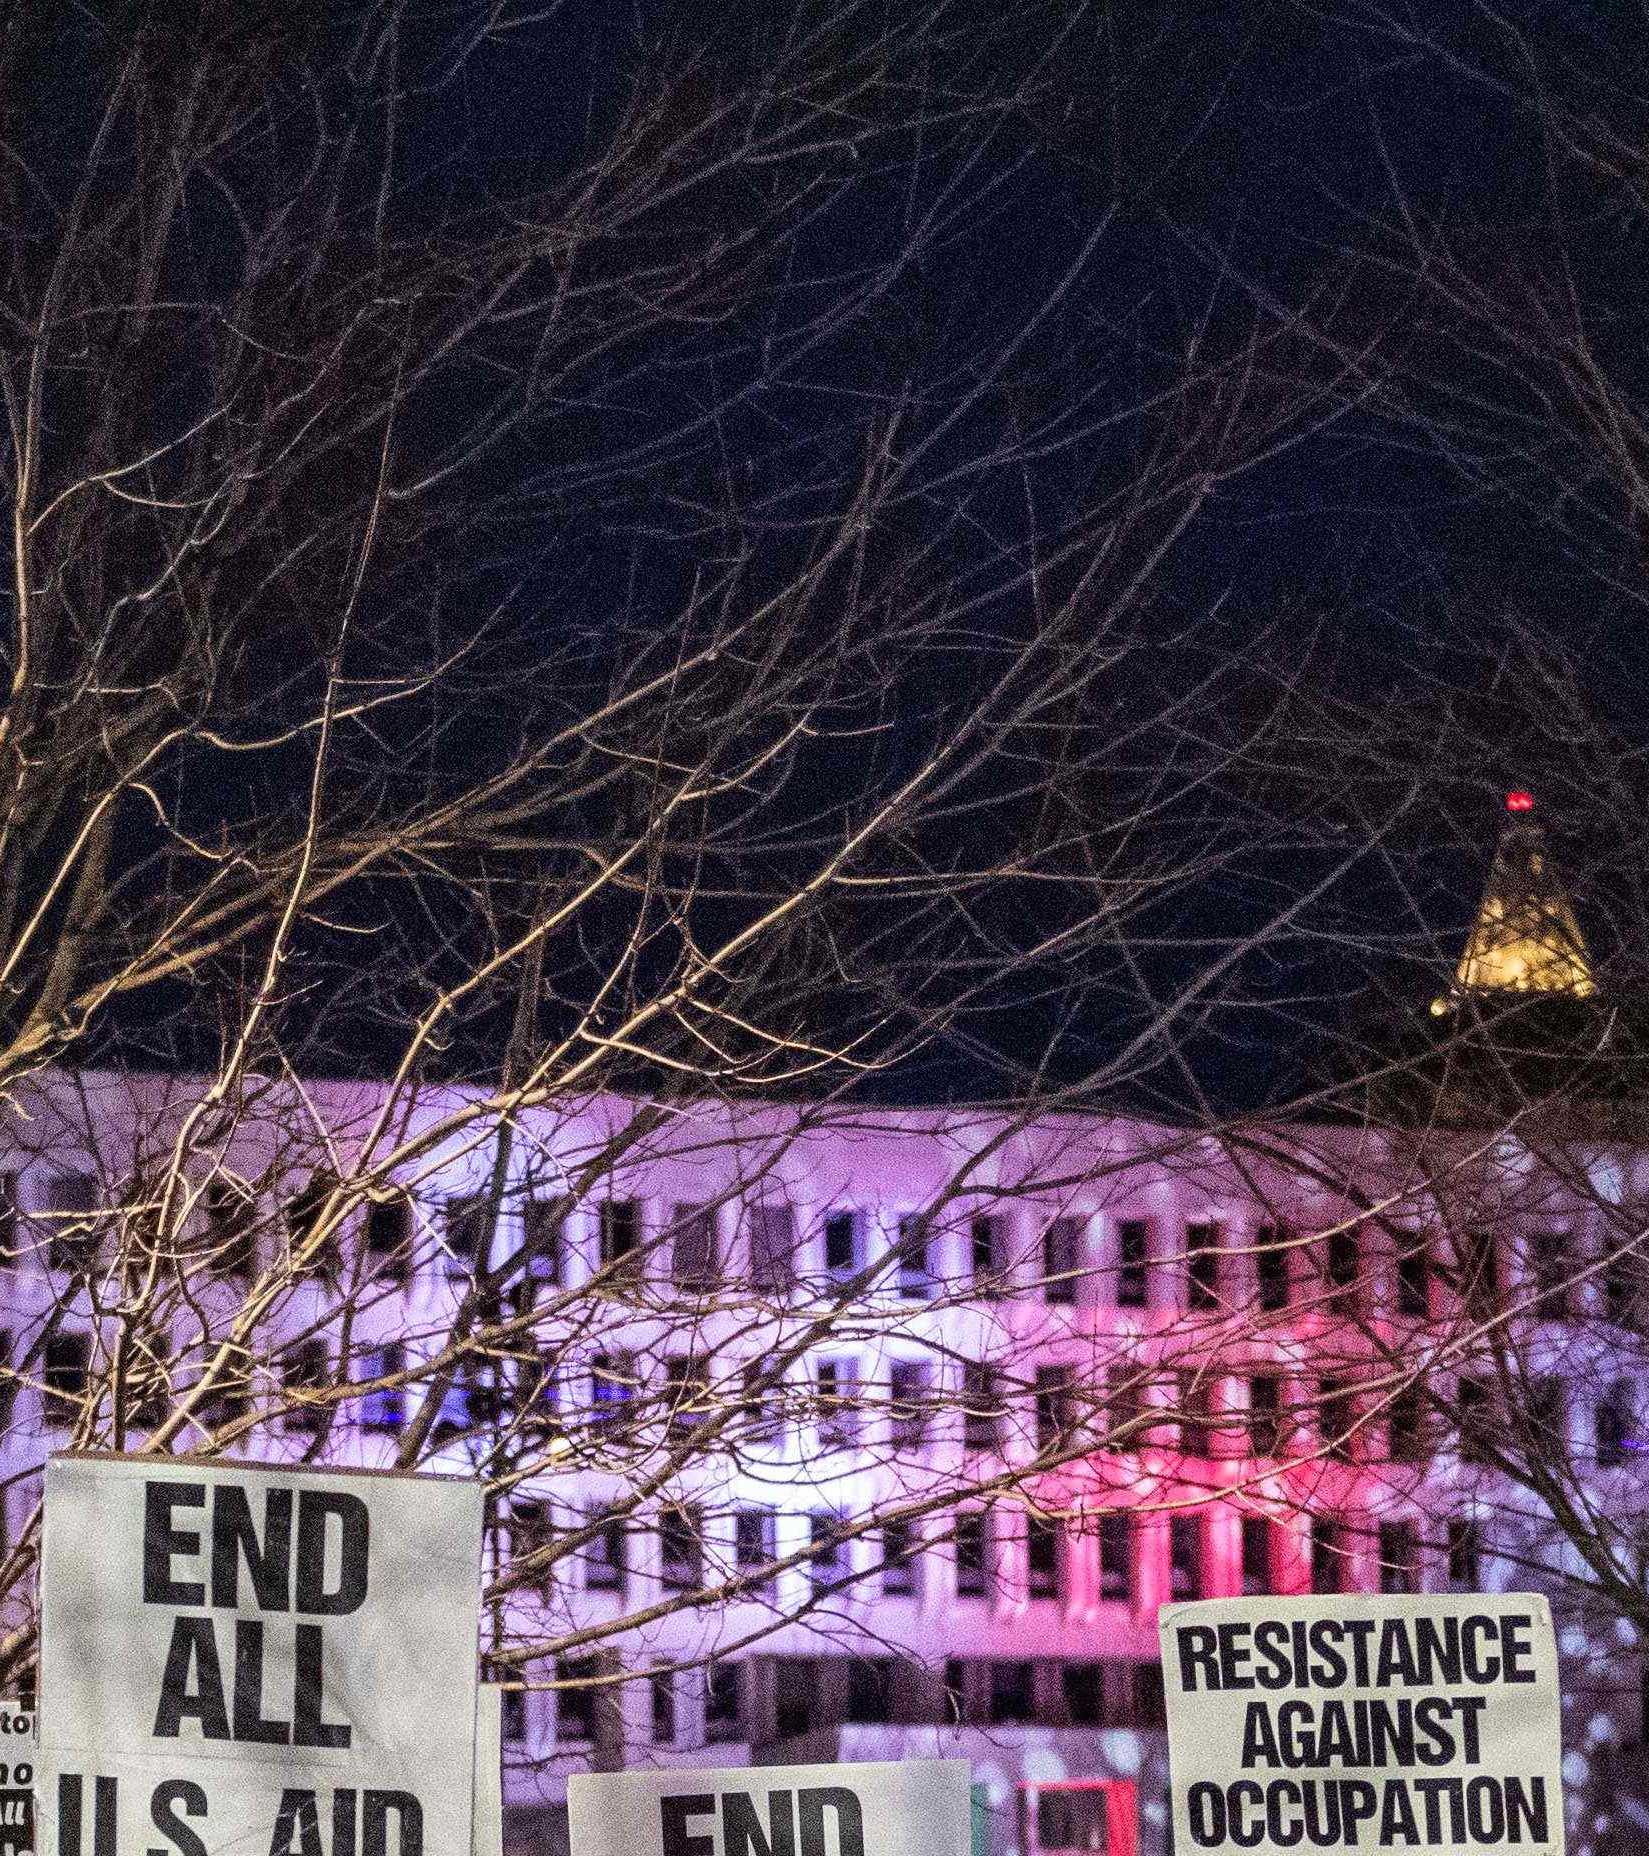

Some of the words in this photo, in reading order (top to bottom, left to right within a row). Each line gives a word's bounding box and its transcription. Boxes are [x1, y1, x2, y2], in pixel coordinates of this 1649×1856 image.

[142, 1481, 370, 1616] END
[152, 1617, 353, 1749] ALL
[1177, 1615, 1536, 1692] RESISTANCE
[1241, 1697, 1486, 1768] AGAINST
[1188, 1775, 1548, 1847] OCCUPATION
